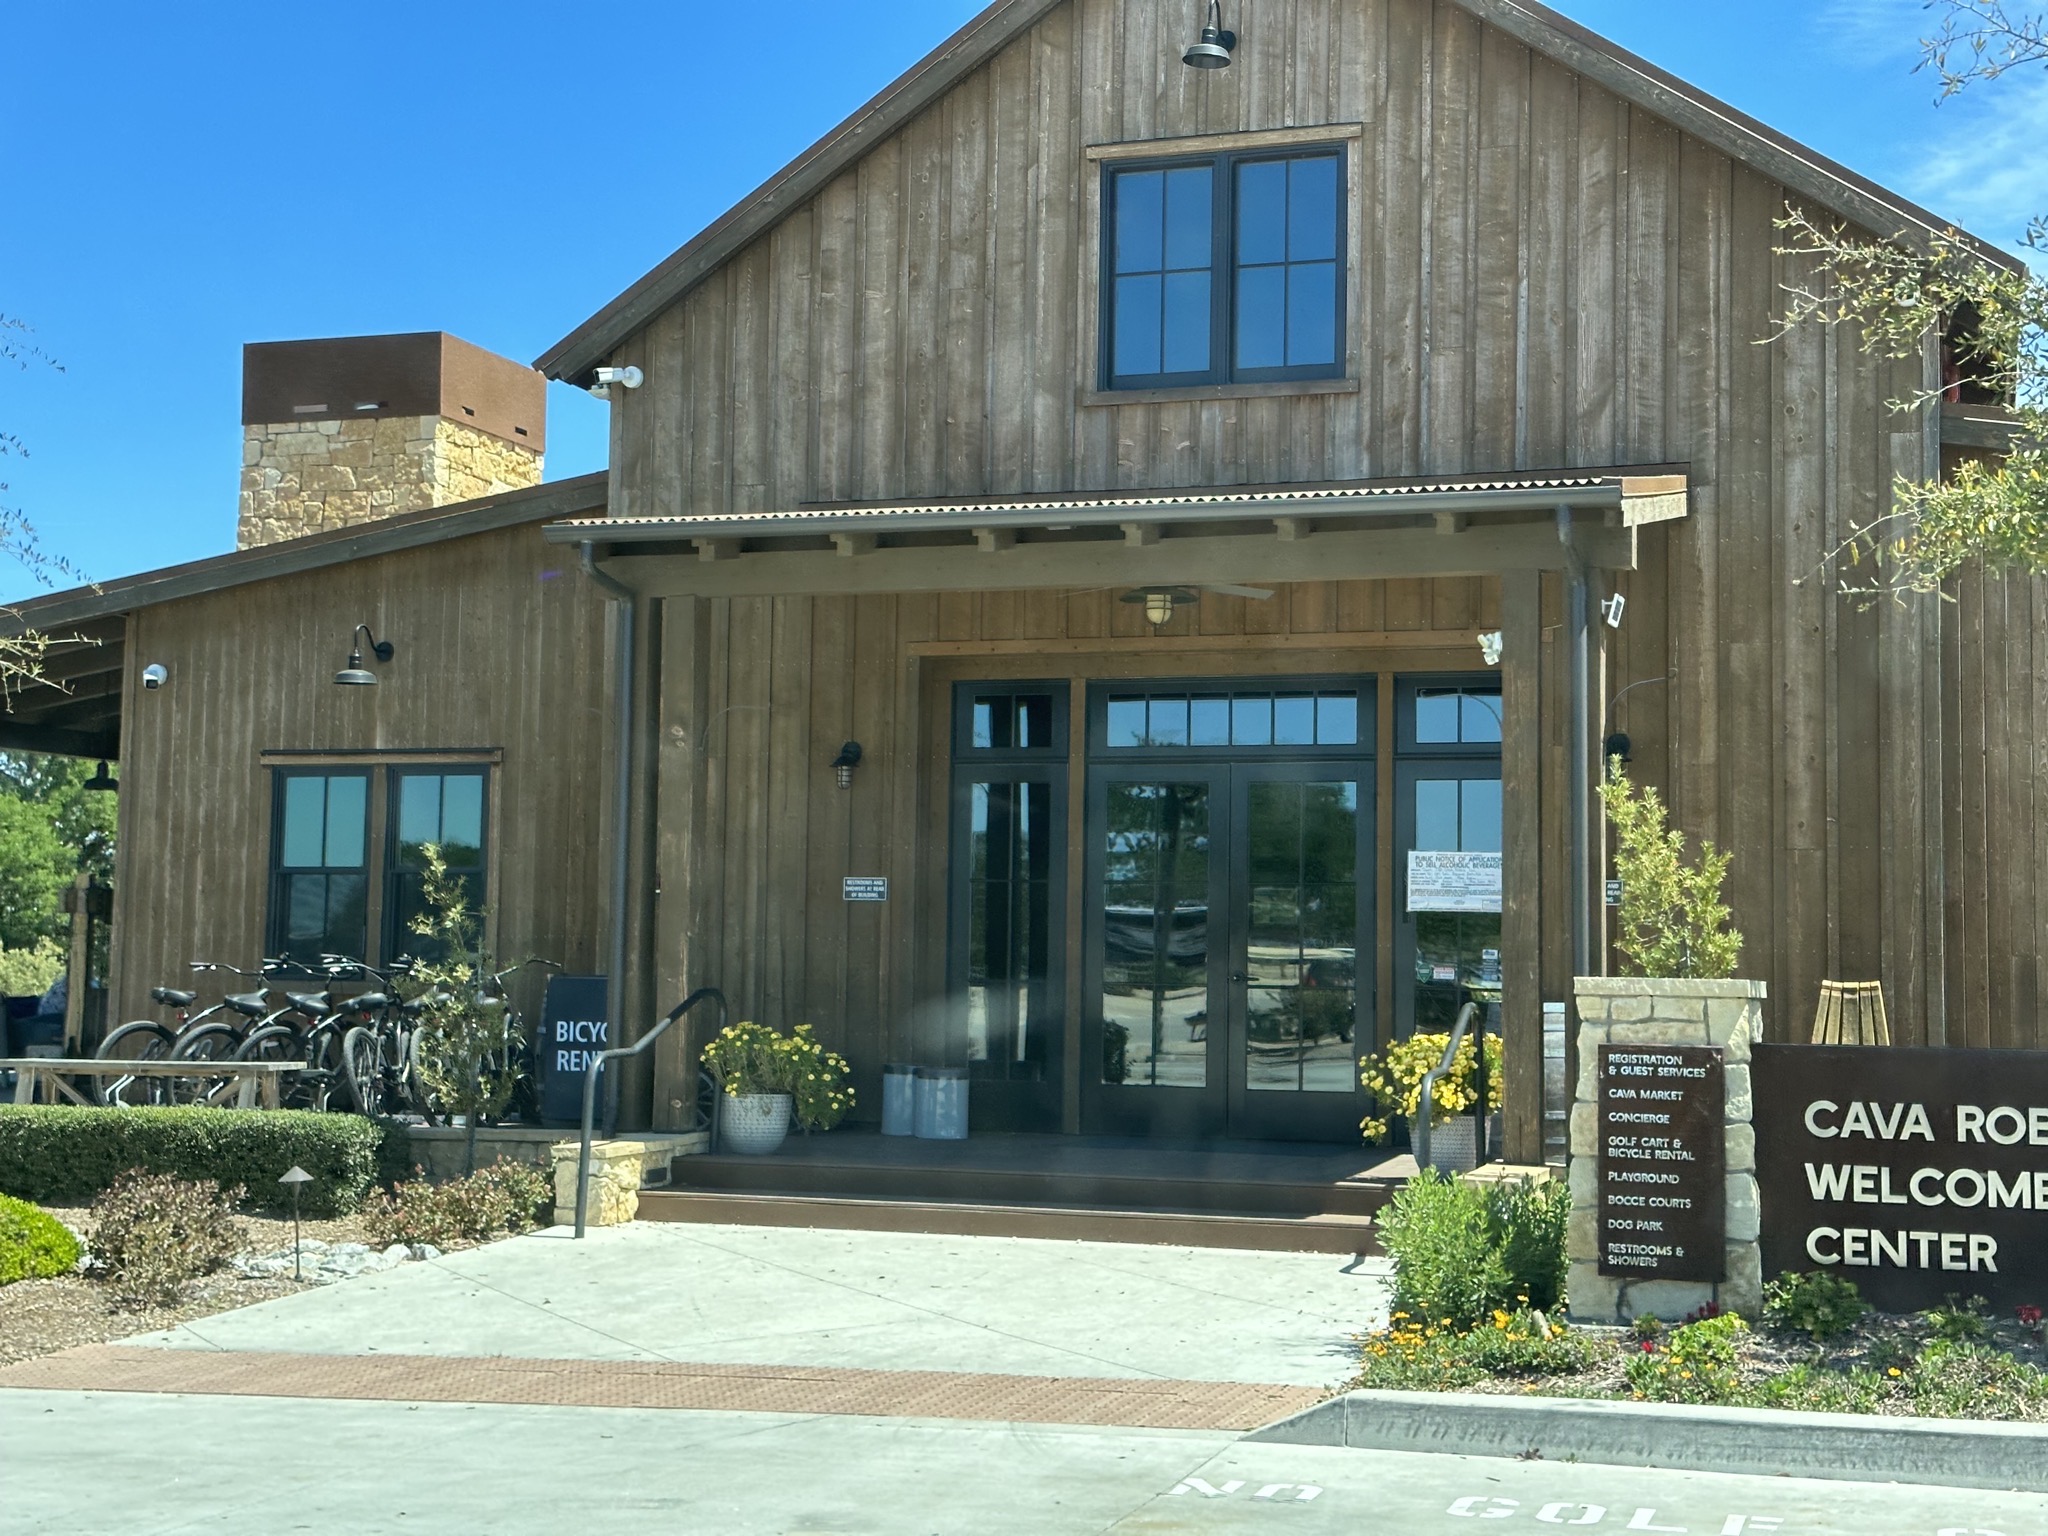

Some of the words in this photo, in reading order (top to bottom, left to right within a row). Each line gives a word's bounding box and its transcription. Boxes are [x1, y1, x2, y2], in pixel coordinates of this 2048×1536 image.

[1608, 1054, 1682, 1065] REGISTRATION
[1608, 1066, 1616, 1076] &
[1620, 1066, 1654, 1077] GUEST
[1658, 1067, 1706, 1078] SERVICES
[1608, 1089, 1636, 1099] CAVA
[1640, 1090, 1683, 1101] MARKET
[1608, 1112, 1670, 1124] CONCIERGE
[1804, 1100, 1935, 1141] CAVA
[1608, 1136, 1637, 1147] GOLF
[1641, 1137, 1669, 1148] CART
[1673, 1139, 1682, 1148] &
[1608, 1148, 1652, 1159] BICYCLE
[1655, 1150, 1695, 1161] RENTAL
[1608, 1172, 1679, 1184] PLAYGROUND
[1608, 1195, 1646, 1206] BOCCE
[1649, 1197, 1691, 1209] COURTS
[1608, 1220, 1633, 1230] DOG
[1637, 1220, 1663, 1232] PARK
[1608, 1243, 1672, 1256] RESTROOMS
[1676, 1246, 1684, 1257] &
[1806, 1227, 1998, 1273] CENTER
[1608, 1256, 1658, 1267] SHOWERS
[1168, 1478, 1323, 1501] NO
[1446, 1496, 1784, 1536] GOLF
